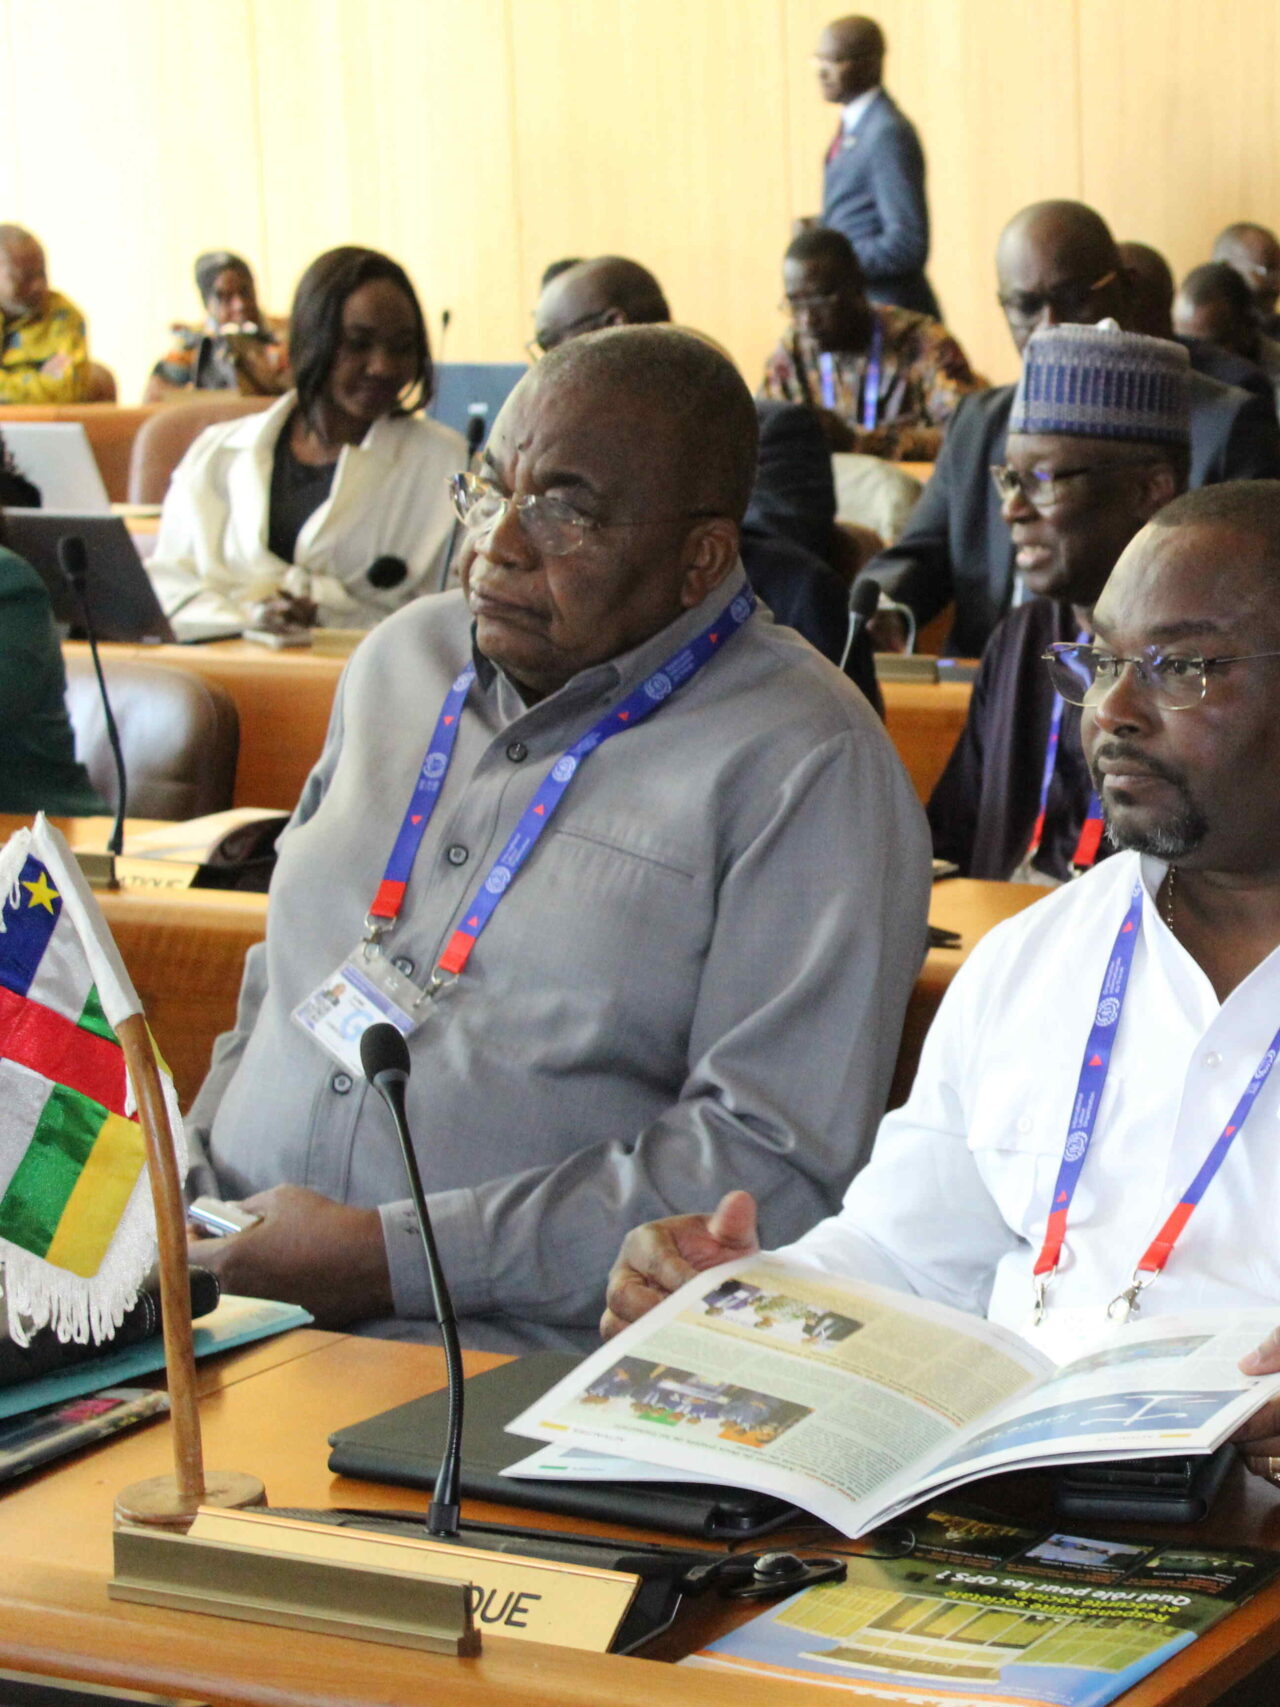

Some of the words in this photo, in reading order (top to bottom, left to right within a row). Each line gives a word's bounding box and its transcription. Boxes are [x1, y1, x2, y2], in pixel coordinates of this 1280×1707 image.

[951, 1571, 998, 1585] OPS
[1002, 1578, 1034, 1591] les
[1035, 1583, 1092, 1597] pour
[1139, 1593, 1192, 1606] Quel
